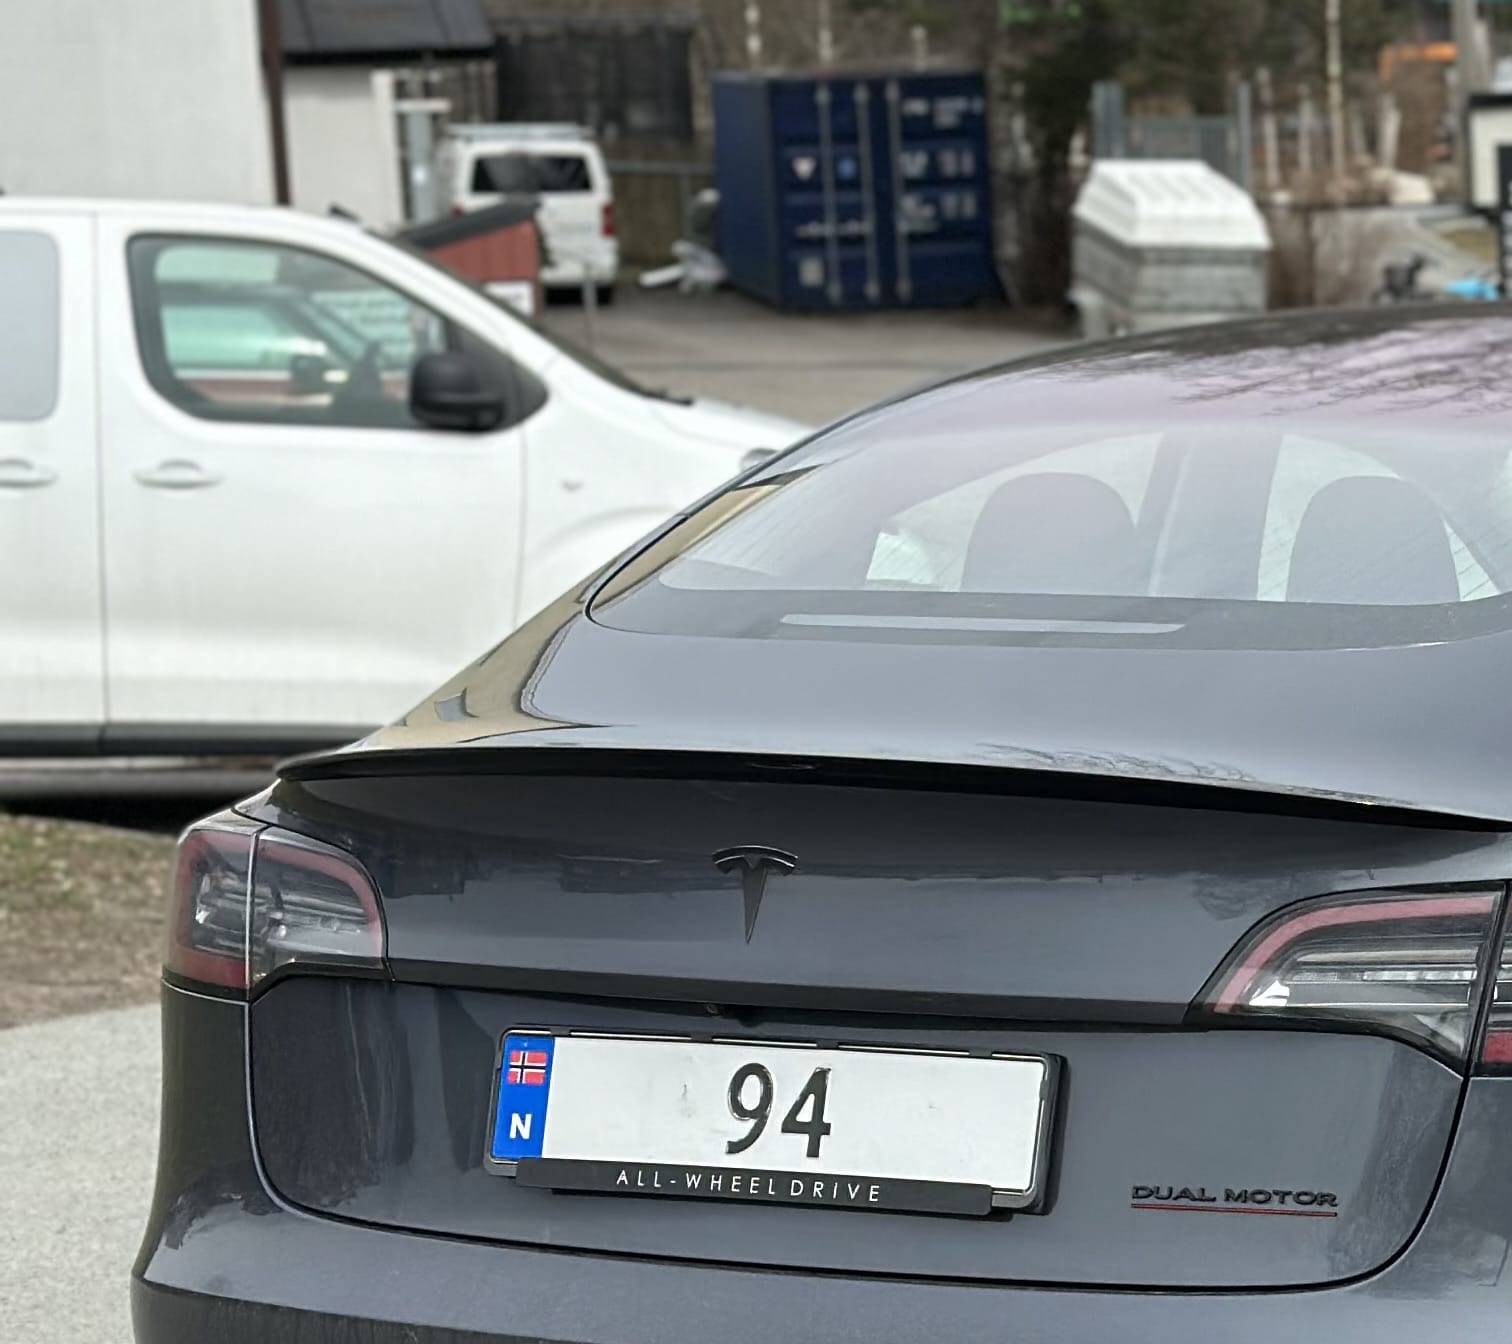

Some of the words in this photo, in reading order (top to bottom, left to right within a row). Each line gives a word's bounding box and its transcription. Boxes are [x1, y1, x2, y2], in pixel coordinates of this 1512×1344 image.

[725, 1062, 832, 1157] 94
[509, 1112, 532, 1140] N
[1131, 1184, 1217, 1202] DUAL
[1223, 1188, 1339, 1207] MOTOR
